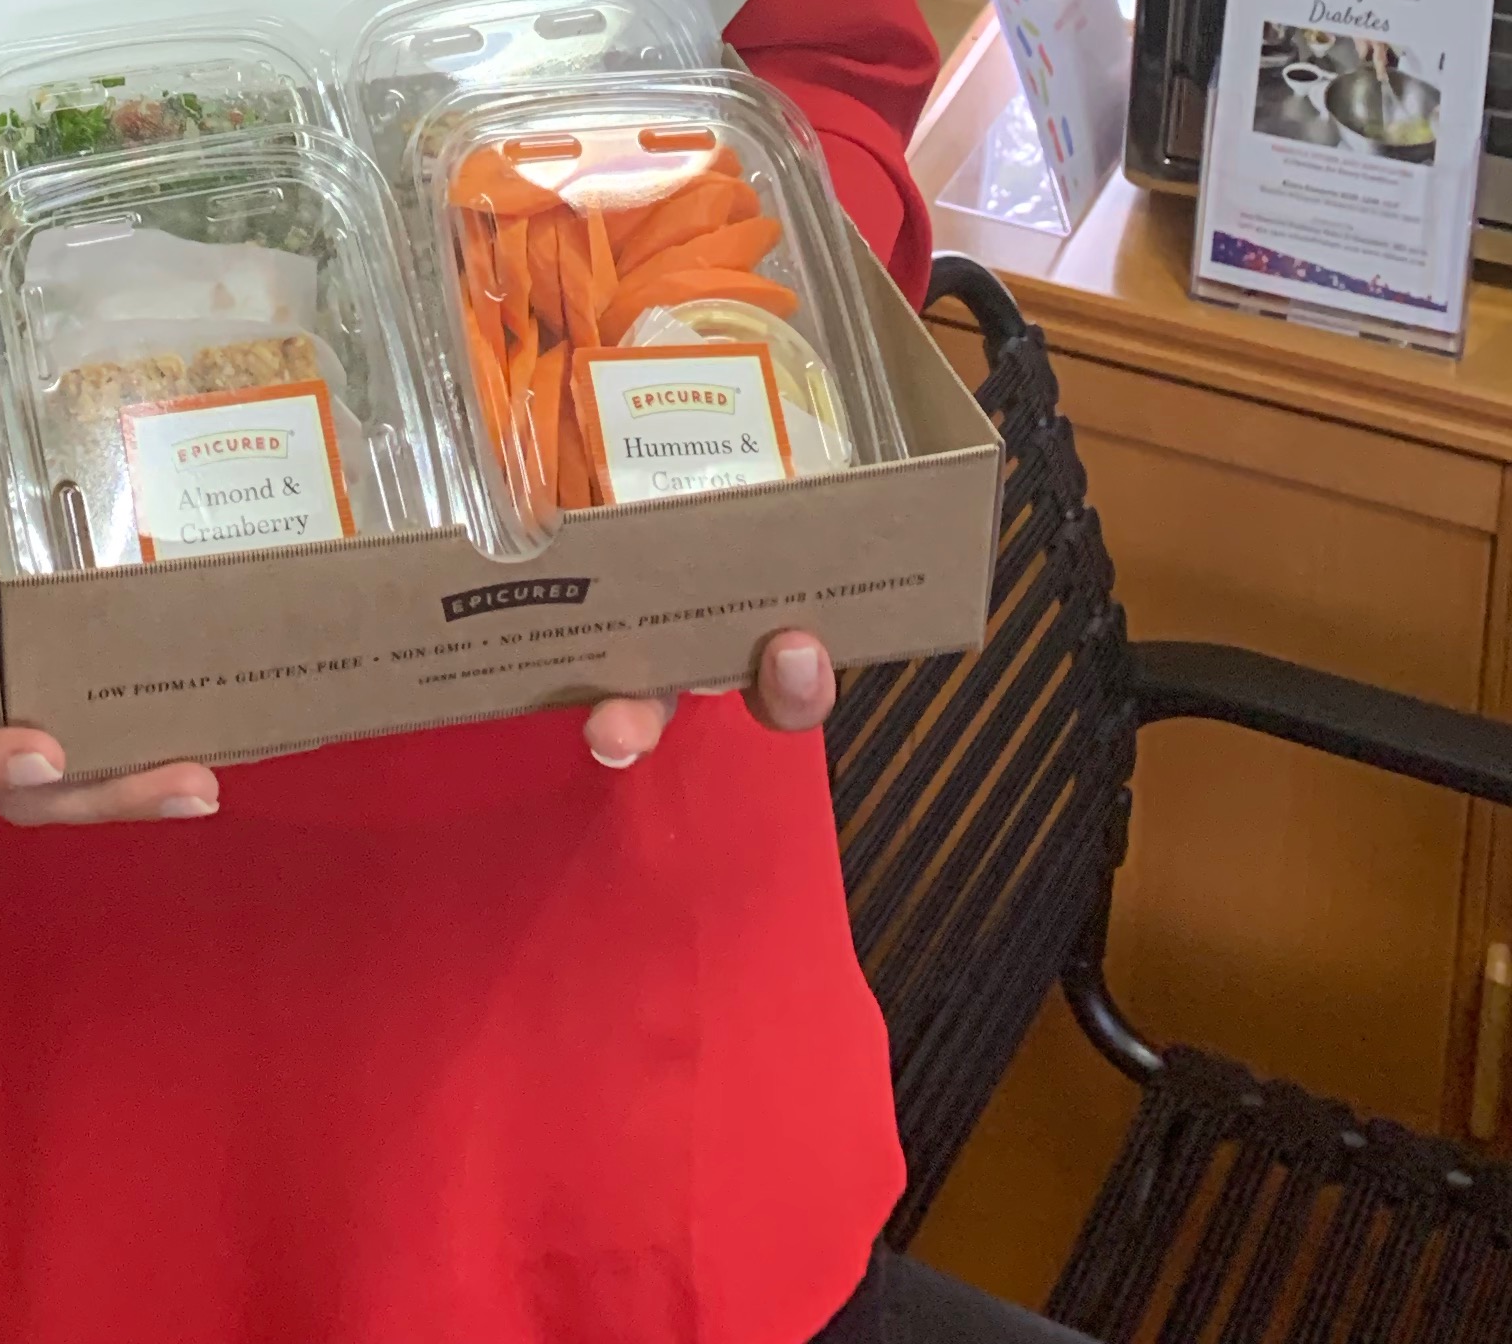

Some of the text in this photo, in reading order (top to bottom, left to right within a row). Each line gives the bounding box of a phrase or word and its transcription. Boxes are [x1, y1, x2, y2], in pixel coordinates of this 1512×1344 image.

[632, 389, 728, 410] EPICURED
[176, 435, 282, 464] EPICURED
[623, 432, 761, 459] Hummus &
[178, 474, 302, 511] Almond &
[652, 470, 748, 492] Carrots
[179, 513, 310, 545] Cranberry
[451, 583, 581, 615] EPICURED
[499, 631, 524, 646] NO
[637, 596, 779, 628] PRESERVATIVES
[814, 572, 927, 602] ANTIBIOTICS
[390, 646, 427, 662] NON
[86, 685, 128, 702] LOW
[133, 675, 212, 697] FODMAP
[235, 663, 310, 685] GLUTEN
[316, 655, 365, 674] FREE
